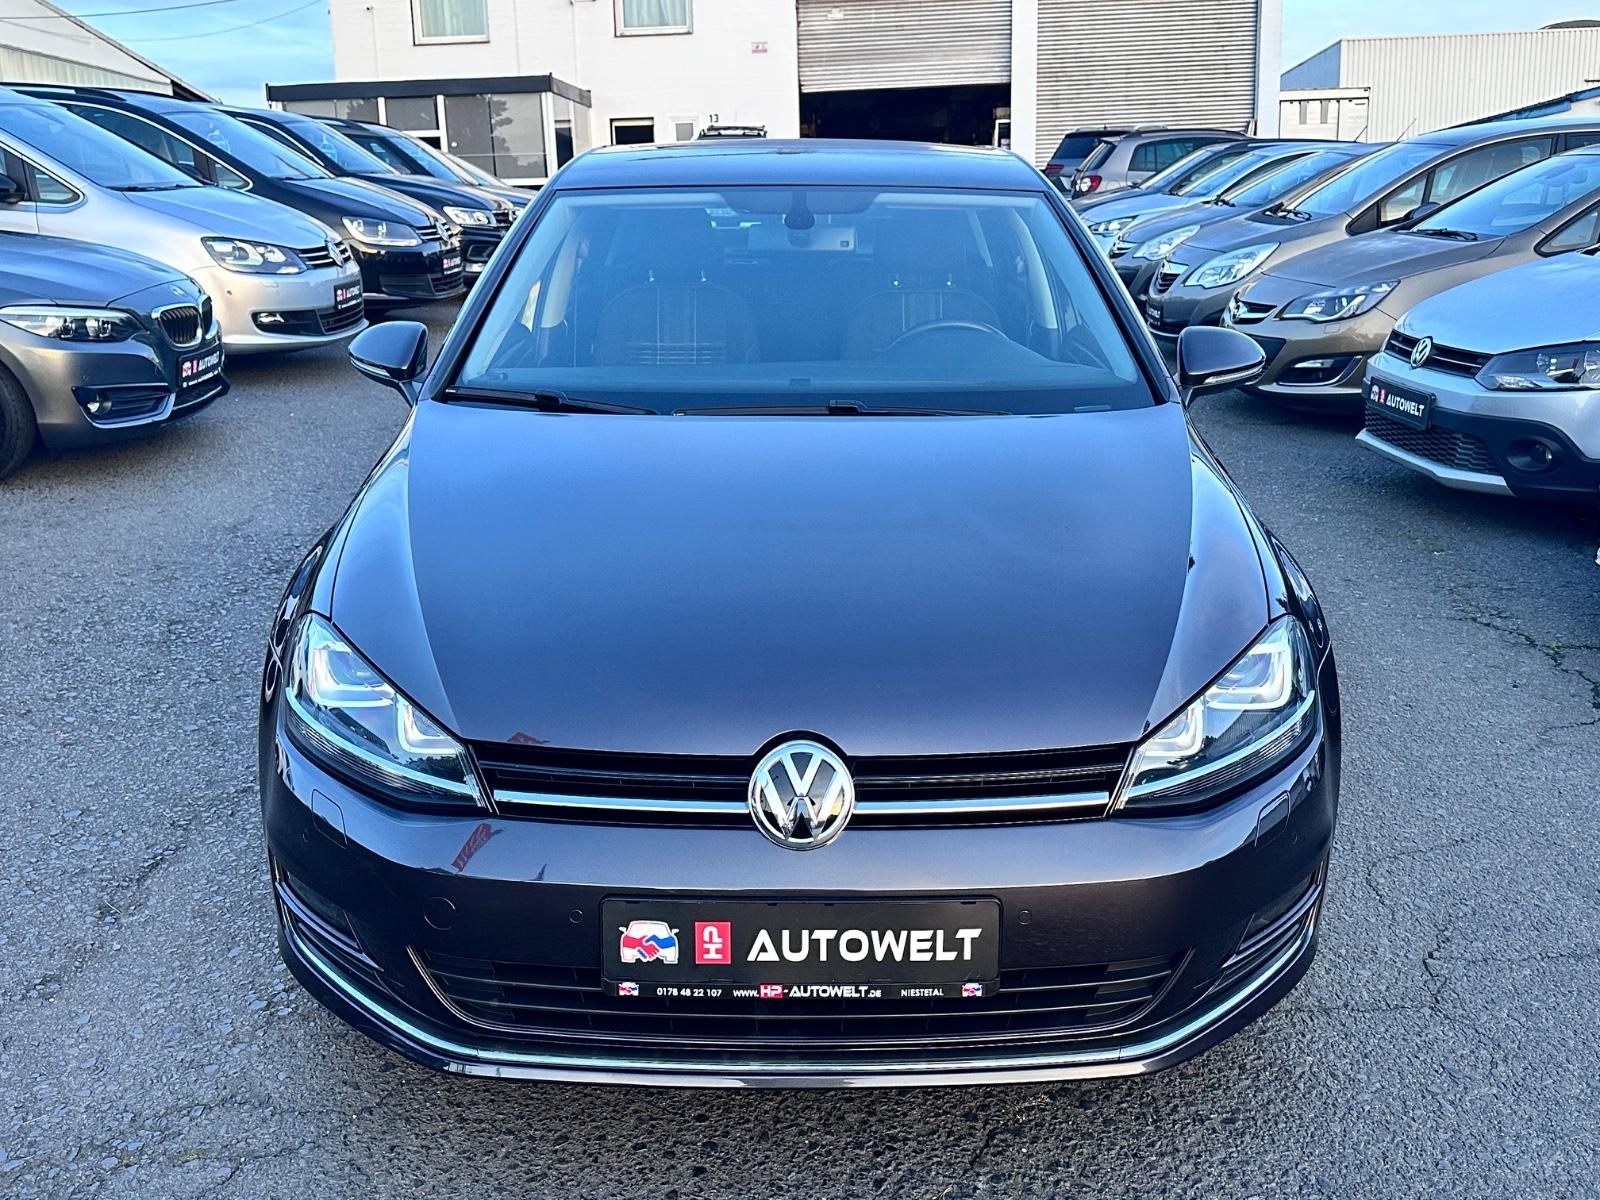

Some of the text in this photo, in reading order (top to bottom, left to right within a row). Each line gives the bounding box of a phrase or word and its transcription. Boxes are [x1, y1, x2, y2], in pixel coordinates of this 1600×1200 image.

[709, 113, 719, 123] 13
[1386, 393, 1425, 417] AUTOWELT
[703, 925, 983, 962] HP AUTOWELT
[656, 987, 678, 996] 0178
[680, 988, 691, 997] 48
[693, 988, 704, 997] 22
[706, 989, 722, 997] 107
[901, 988, 944, 997] NIESTETAL
